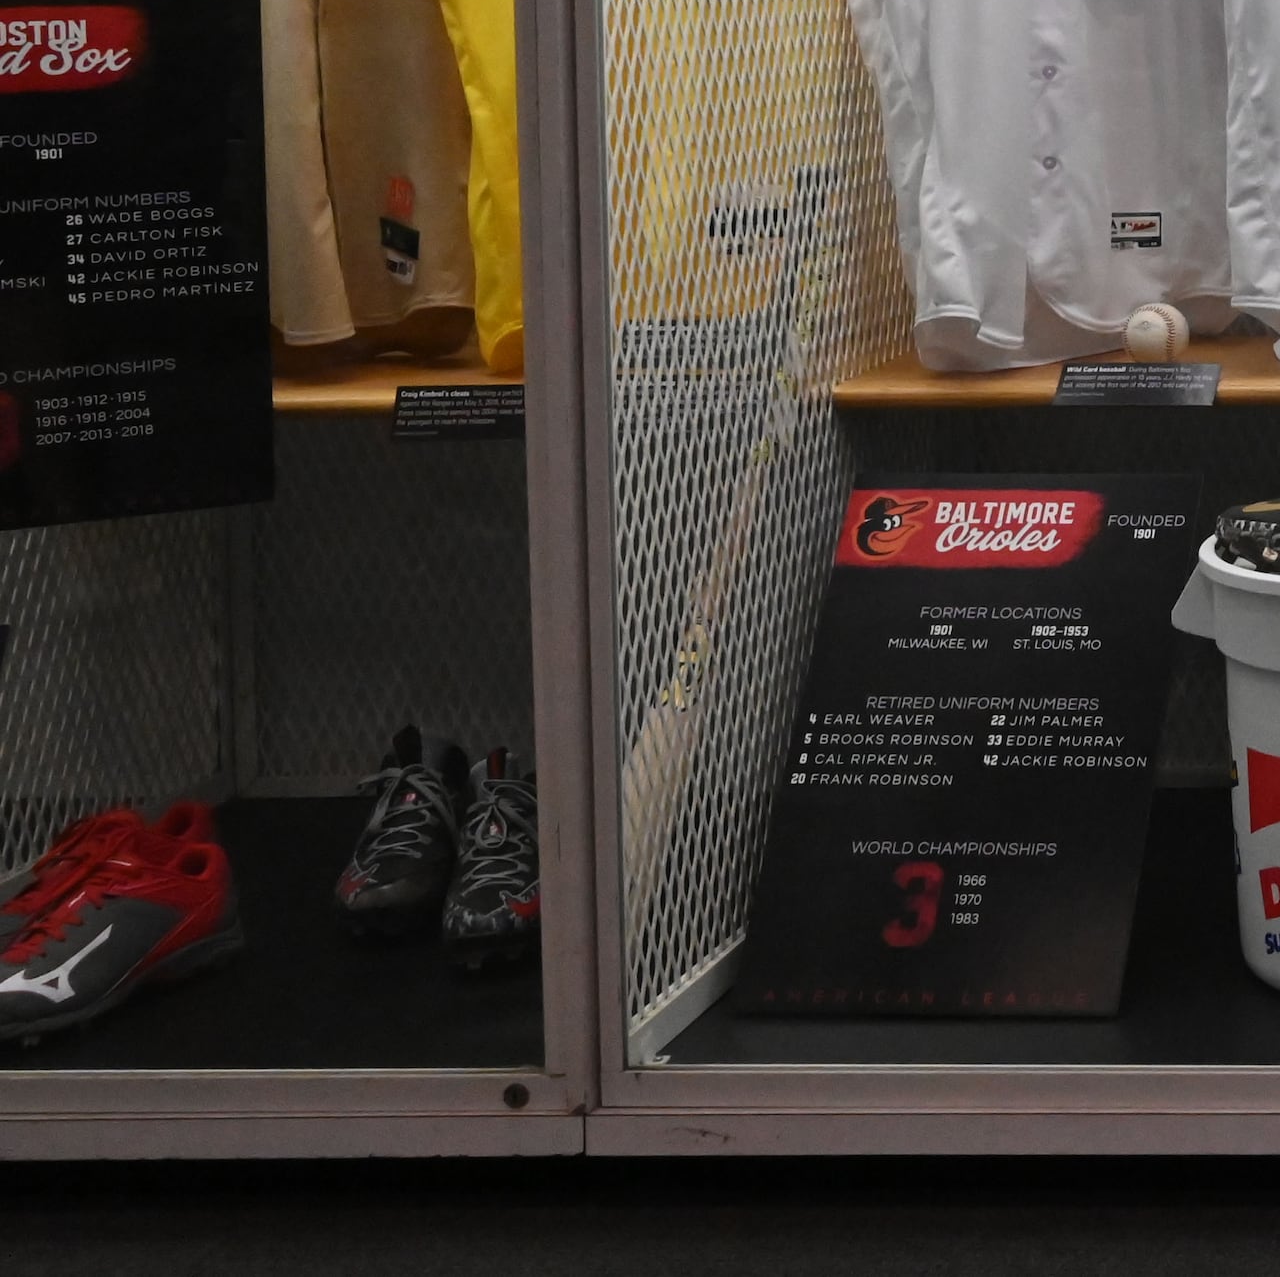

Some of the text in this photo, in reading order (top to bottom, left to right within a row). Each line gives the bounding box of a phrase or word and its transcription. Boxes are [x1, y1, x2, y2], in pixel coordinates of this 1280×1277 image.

[40, 39, 131, 75] Sox
[0, 131, 98, 148] FOUNDED
[35, 148, 63, 160] 1901
[0, 191, 191, 214] UNIFORM NUMBERS
[67, 246, 207, 265] 34 DAVID ORTIZ
[13, 357, 177, 384] CHAMPIONSHIPS
[935, 501, 1076, 525] BALTIMORE
[1107, 514, 1185, 527] FOUNDED
[935, 520, 1062, 553] Orioles
[1133, 528, 1155, 539] 1901
[804, 732, 974, 746] 5 BROOKS ROBINSON
[987, 734, 1125, 747] 33 EDDIE MURRAY
[851, 841, 1057, 856] WORLD CHAMPIONSHIPS
[882, 861, 945, 947] 3
[950, 912, 979, 925] 1983
